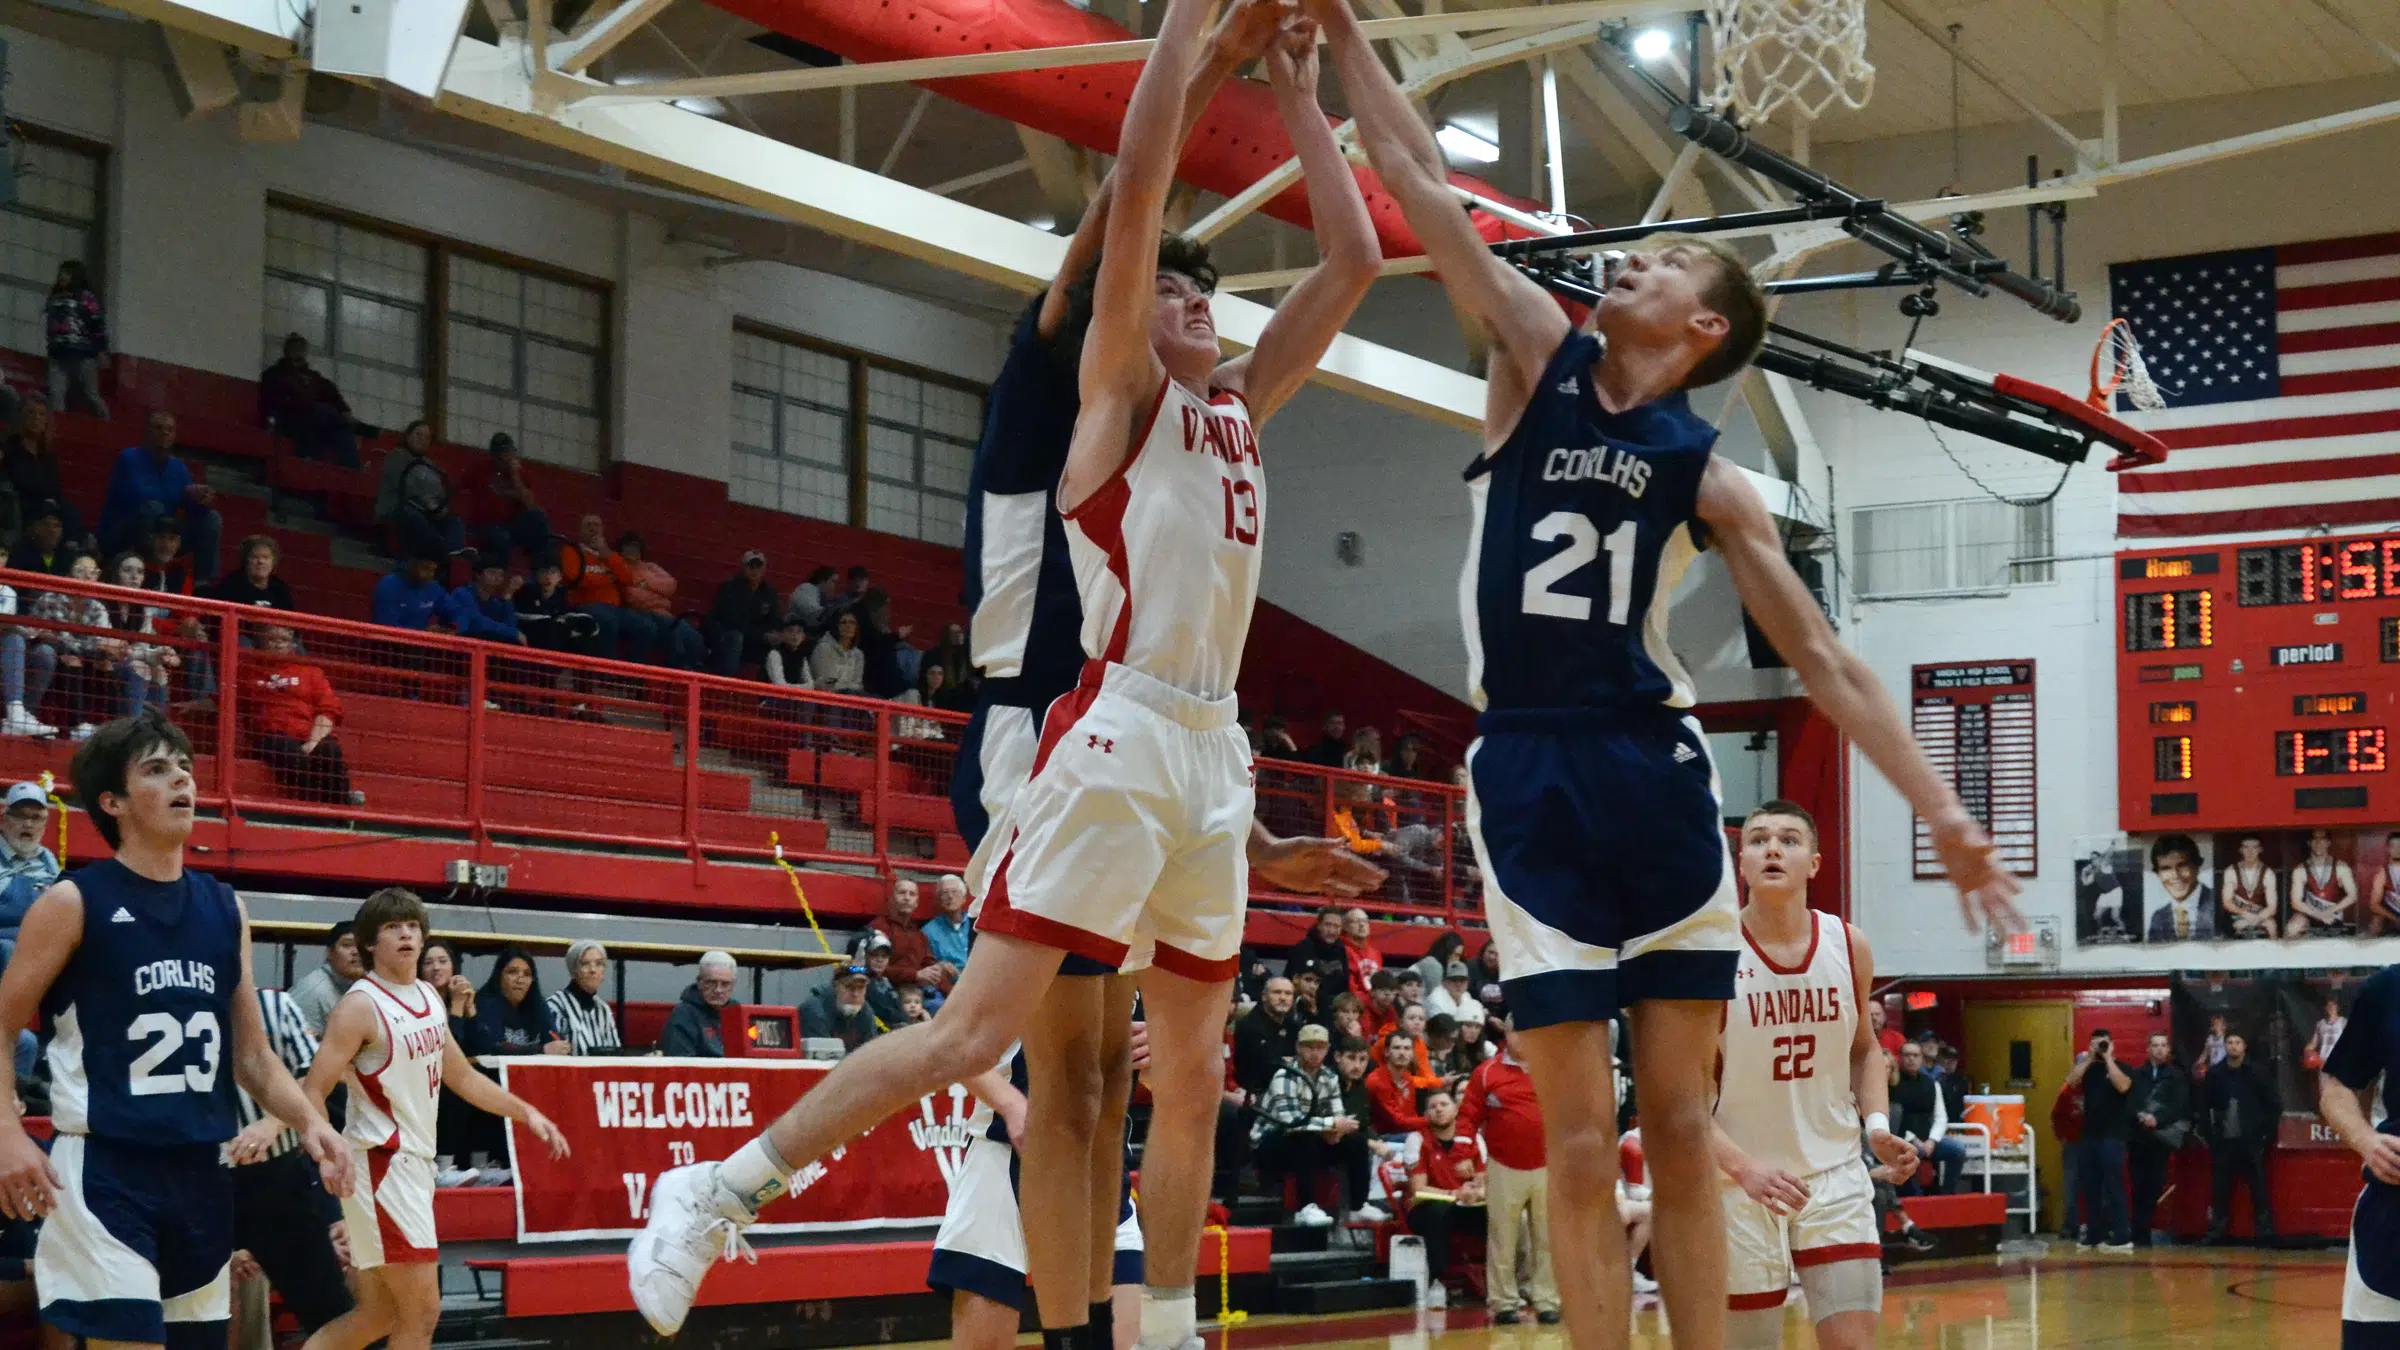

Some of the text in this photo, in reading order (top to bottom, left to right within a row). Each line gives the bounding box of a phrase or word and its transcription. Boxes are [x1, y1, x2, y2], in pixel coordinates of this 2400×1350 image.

[1542, 445, 1653, 499] CORLHS
[1221, 475, 1259, 547] 13
[1521, 510, 1638, 626] 21
[2145, 557, 2193, 578] Home
[2161, 590, 2213, 649] 11
[2278, 643, 2335, 667] period
[1933, 678, 1954, 688] TRACK
[2154, 703, 2193, 723] fouls
[2303, 694, 2357, 716] player
[134, 959, 216, 996] CORLHS
[1747, 986, 1841, 1028] VANDALS
[126, 1010, 222, 1096] 23
[403, 1022, 446, 1060] VANDAL
[1772, 1034, 1816, 1082] 22
[426, 1061, 440, 1099] 14
[592, 1081, 754, 1130] WELCOME
[667, 1141, 696, 1166] TO
